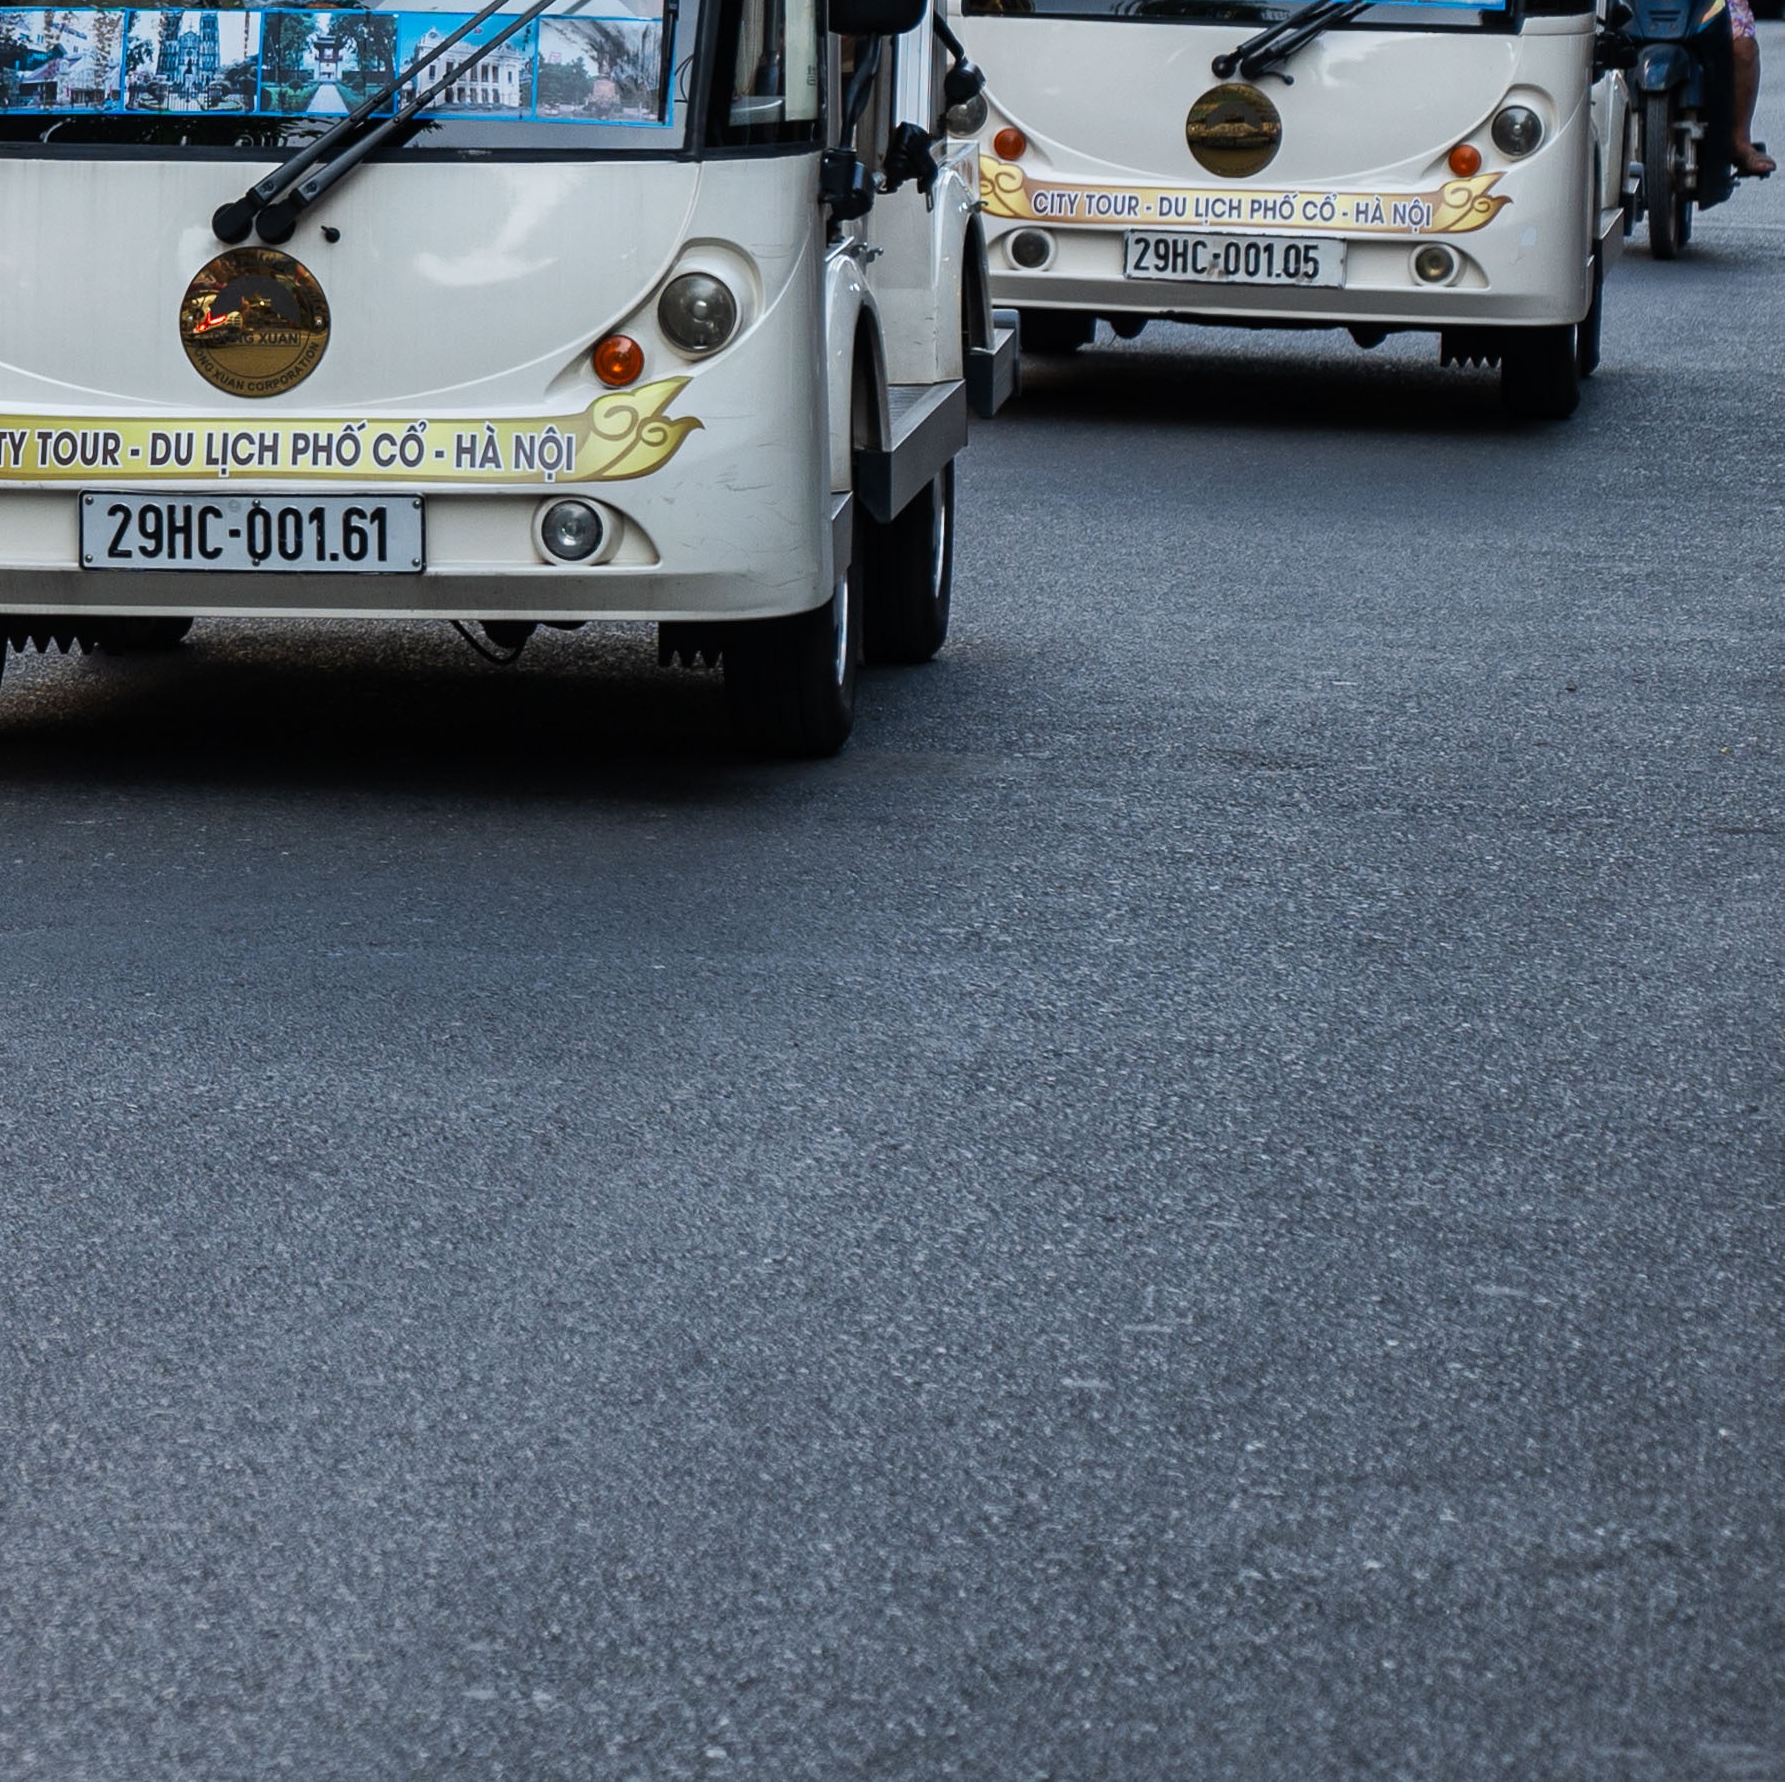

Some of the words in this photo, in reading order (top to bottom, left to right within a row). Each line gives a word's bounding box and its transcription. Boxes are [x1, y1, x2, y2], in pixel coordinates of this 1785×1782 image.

[1032, 191, 1079, 216] CITY
[1084, 193, 1139, 217] TOUR
[1158, 195, 1187, 219] DU
[1192, 197, 1242, 226] LỊCH
[1248, 191, 1300, 220] PHỐ
[1302, 192, 1338, 221] CỔ
[1354, 194, 1385, 226] HÀ
[1391, 200, 1432, 233] NỘI
[1133, 236, 1320, 280] 29HC-001.05
[213, 368, 245, 391] XUAN
[247, 343, 320, 391] CORPORATION
[36, 430, 121, 468] TOUR
[149, 431, 195, 468] DU
[204, 431, 282, 478] LỊCH
[290, 420, 368, 469] PHỐ
[372, 419, 428, 470] CỔ
[454, 423, 505, 472] HÀ
[512, 425, 576, 483] NỘI
[107, 504, 388, 564] 29HC-001.61
